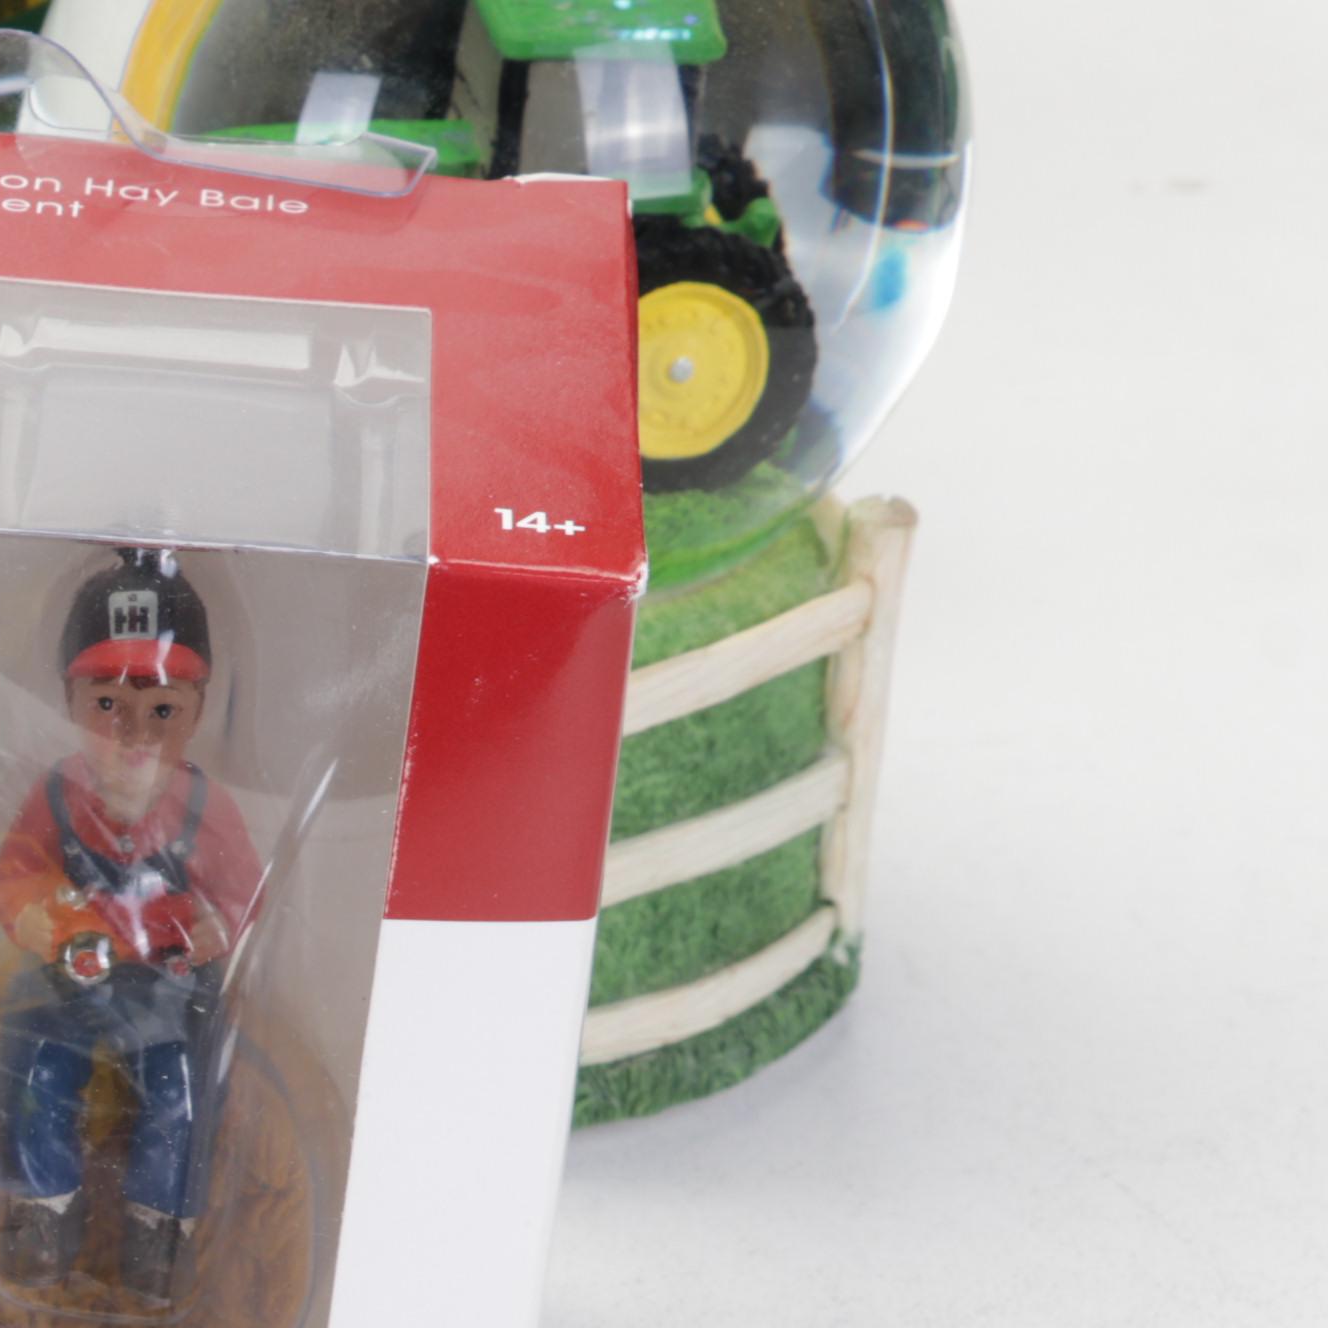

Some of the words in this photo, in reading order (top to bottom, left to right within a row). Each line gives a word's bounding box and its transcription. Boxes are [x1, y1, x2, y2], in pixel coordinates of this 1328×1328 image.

[0, 174, 62, 193] on
[84, 177, 179, 208] Hay
[199, 189, 309, 215] Bale
[494, 507, 586, 536] 14+
